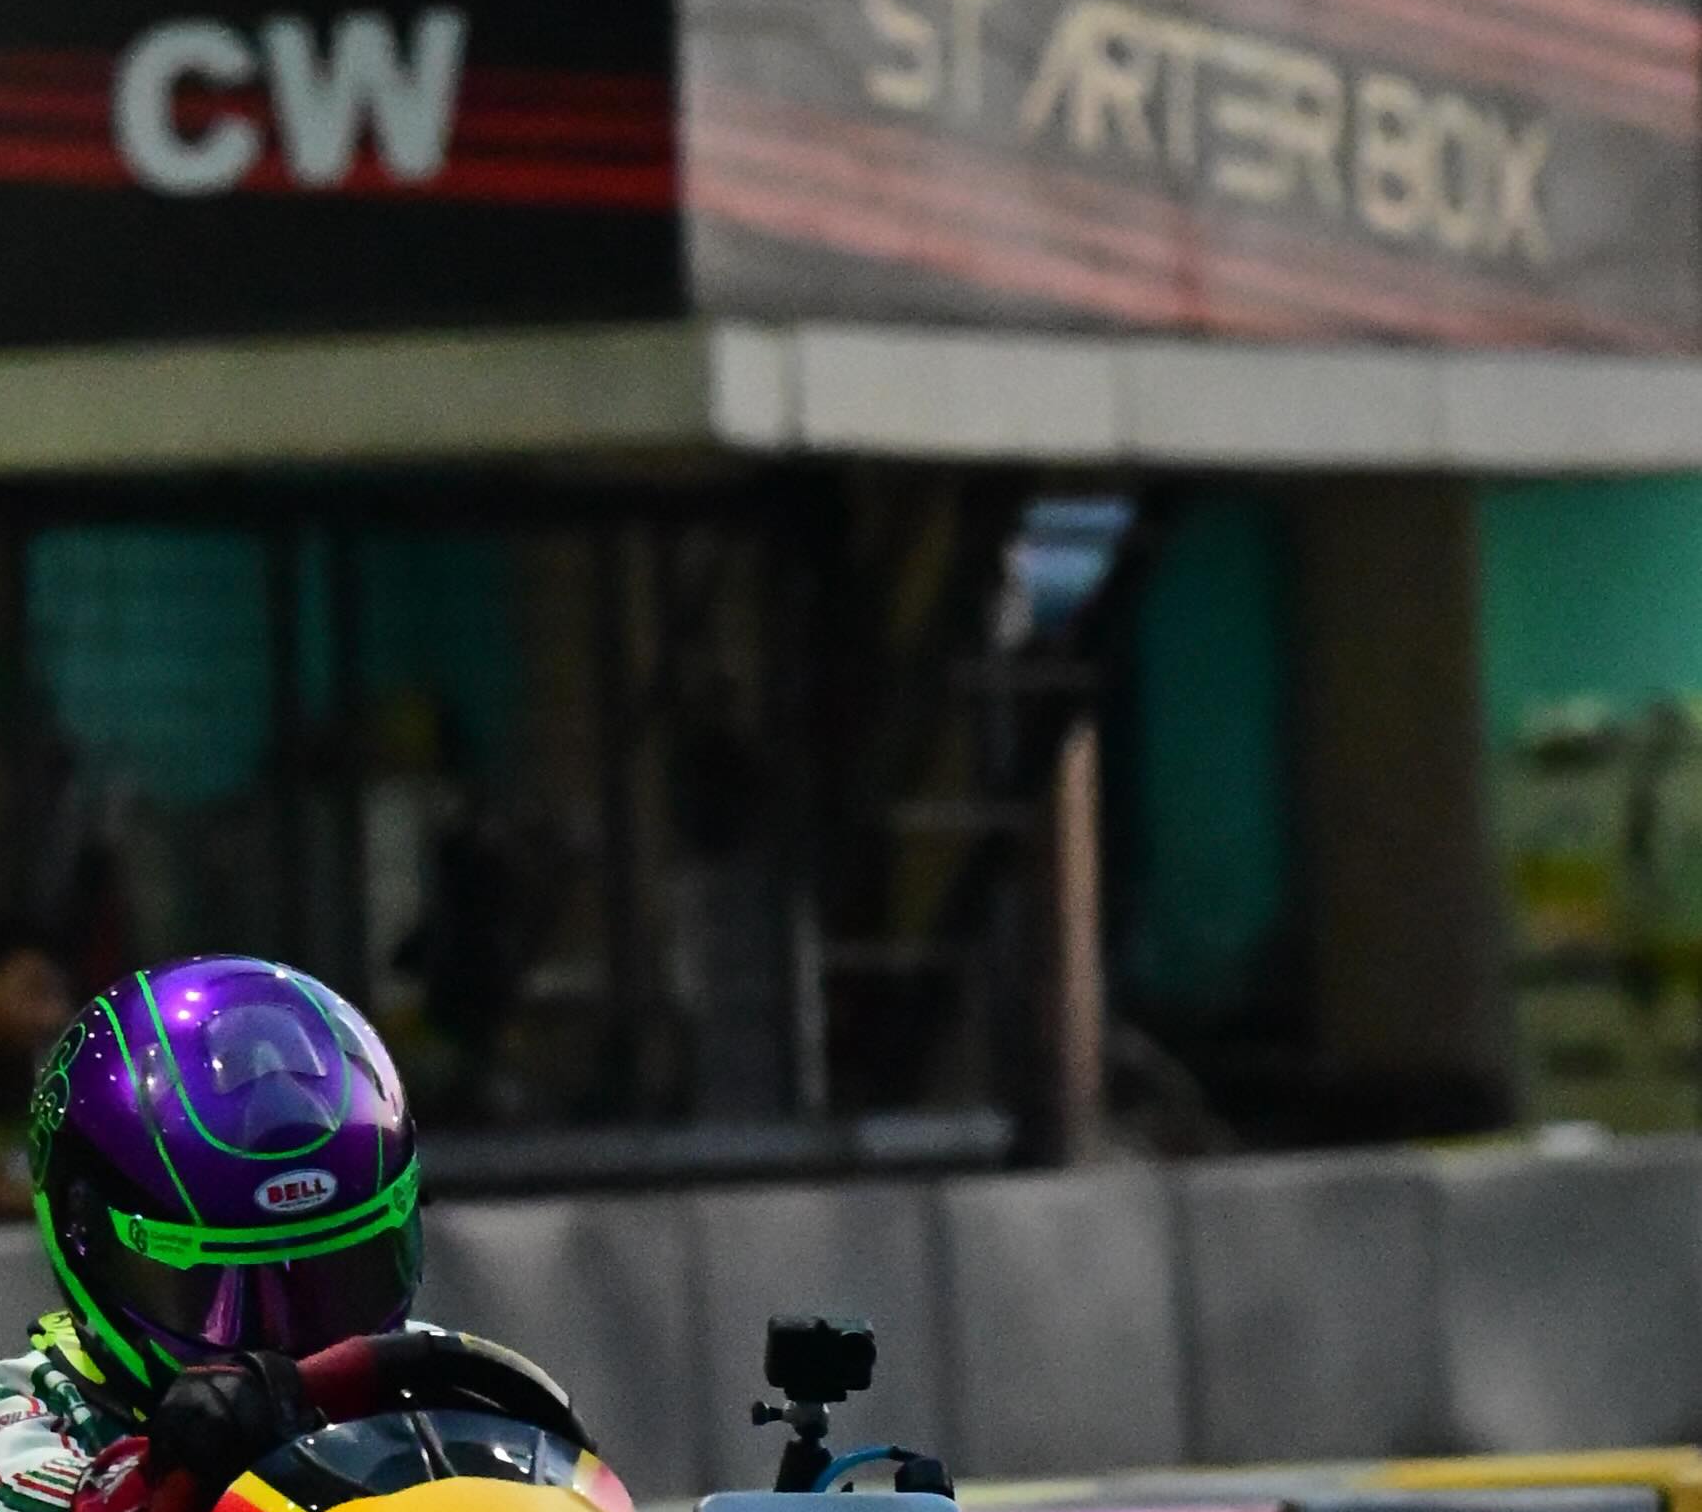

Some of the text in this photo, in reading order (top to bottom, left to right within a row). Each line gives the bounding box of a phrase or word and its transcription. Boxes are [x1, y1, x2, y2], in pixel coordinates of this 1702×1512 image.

[109, 2, 471, 198] CW
[1354, 74, 1550, 264] BOX
[265, 1179, 323, 1204] BELL
